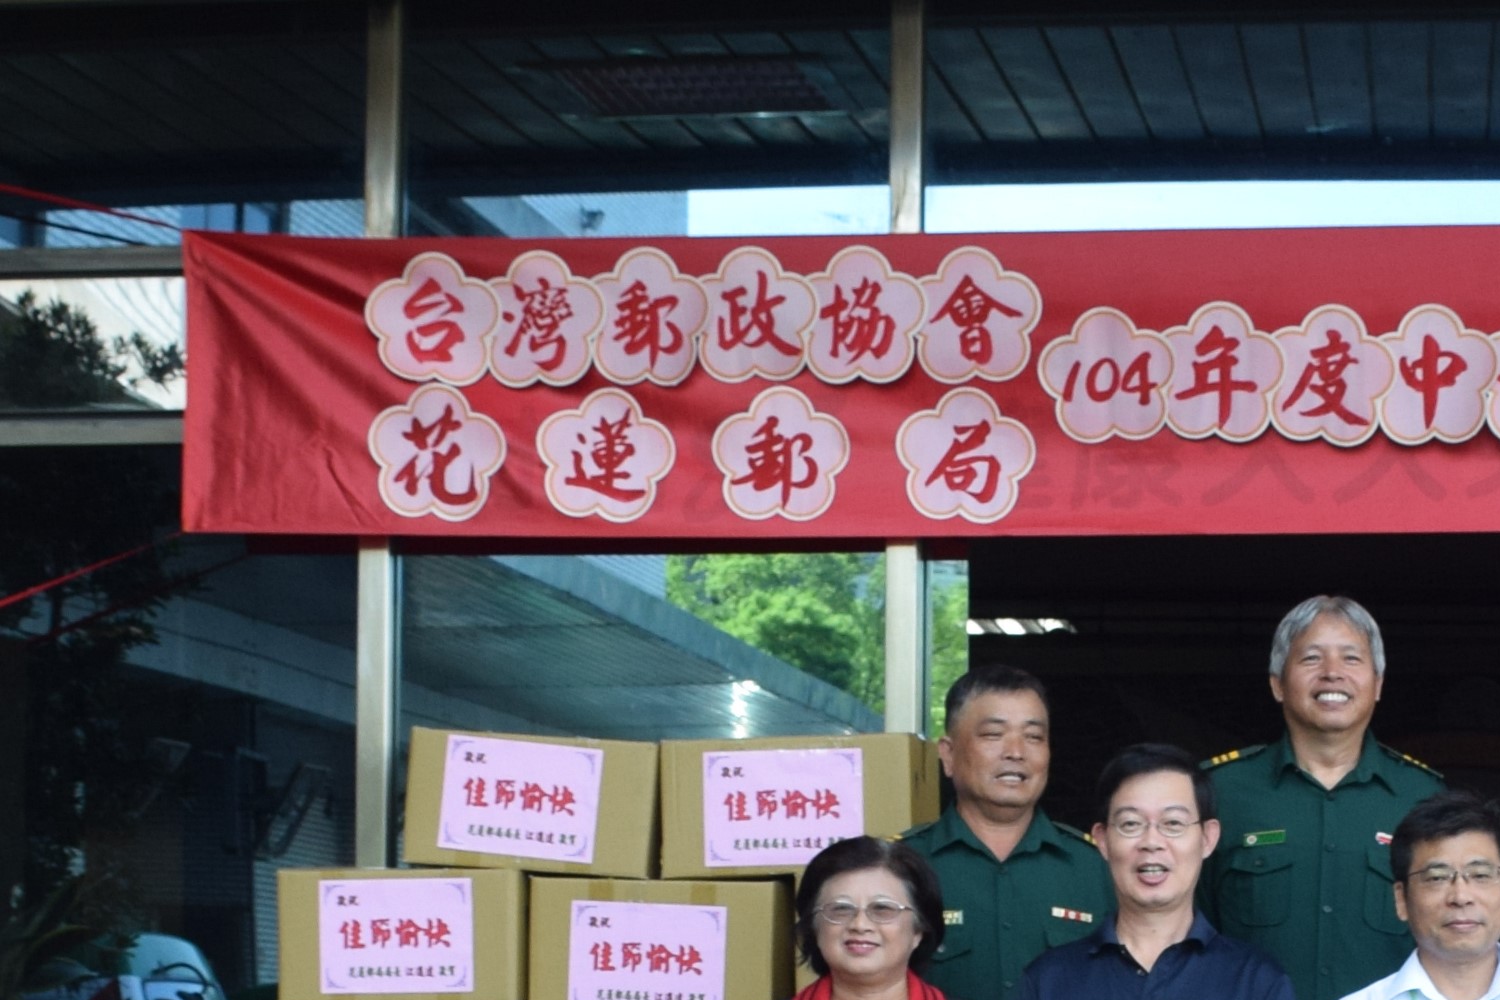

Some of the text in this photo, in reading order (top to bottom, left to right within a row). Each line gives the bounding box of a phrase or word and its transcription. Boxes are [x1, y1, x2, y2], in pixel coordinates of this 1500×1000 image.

[400, 269, 1024, 372] 台灣郵政協會
[394, 402, 1003, 507] 花蓮郵局
[462, 777, 577, 817] 佳節愉快
[724, 789, 841, 823] 佳節愉快
[339, 918, 452, 949] 佳節愉快
[589, 942, 704, 976] 佳節愉快
